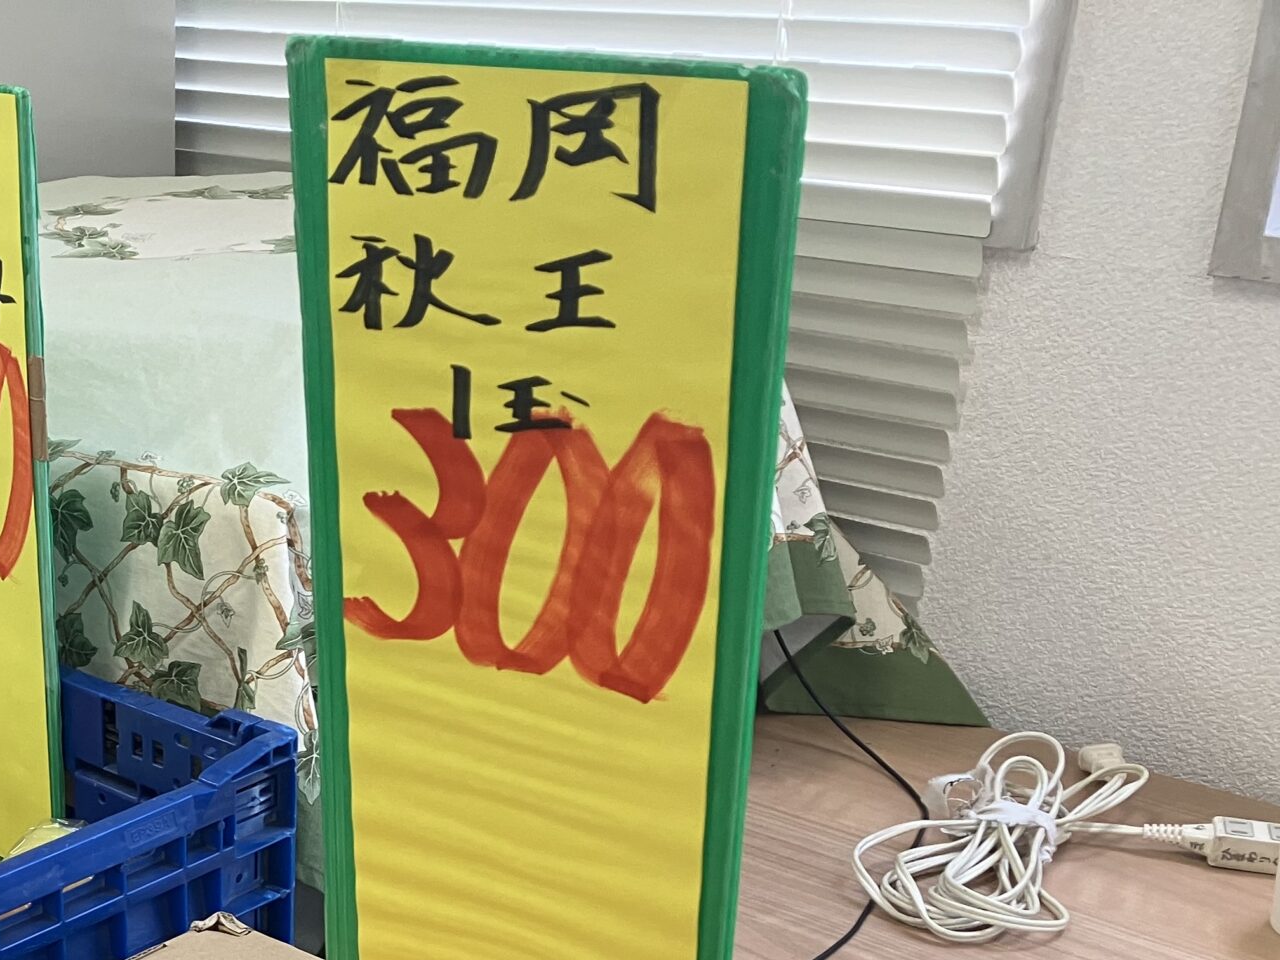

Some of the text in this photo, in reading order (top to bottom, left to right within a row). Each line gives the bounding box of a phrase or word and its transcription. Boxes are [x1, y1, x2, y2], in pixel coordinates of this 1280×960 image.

[326, 74, 662, 214] 福岡
[334, 232, 617, 332] 秋王
[342, 406, 717, 704] 300
